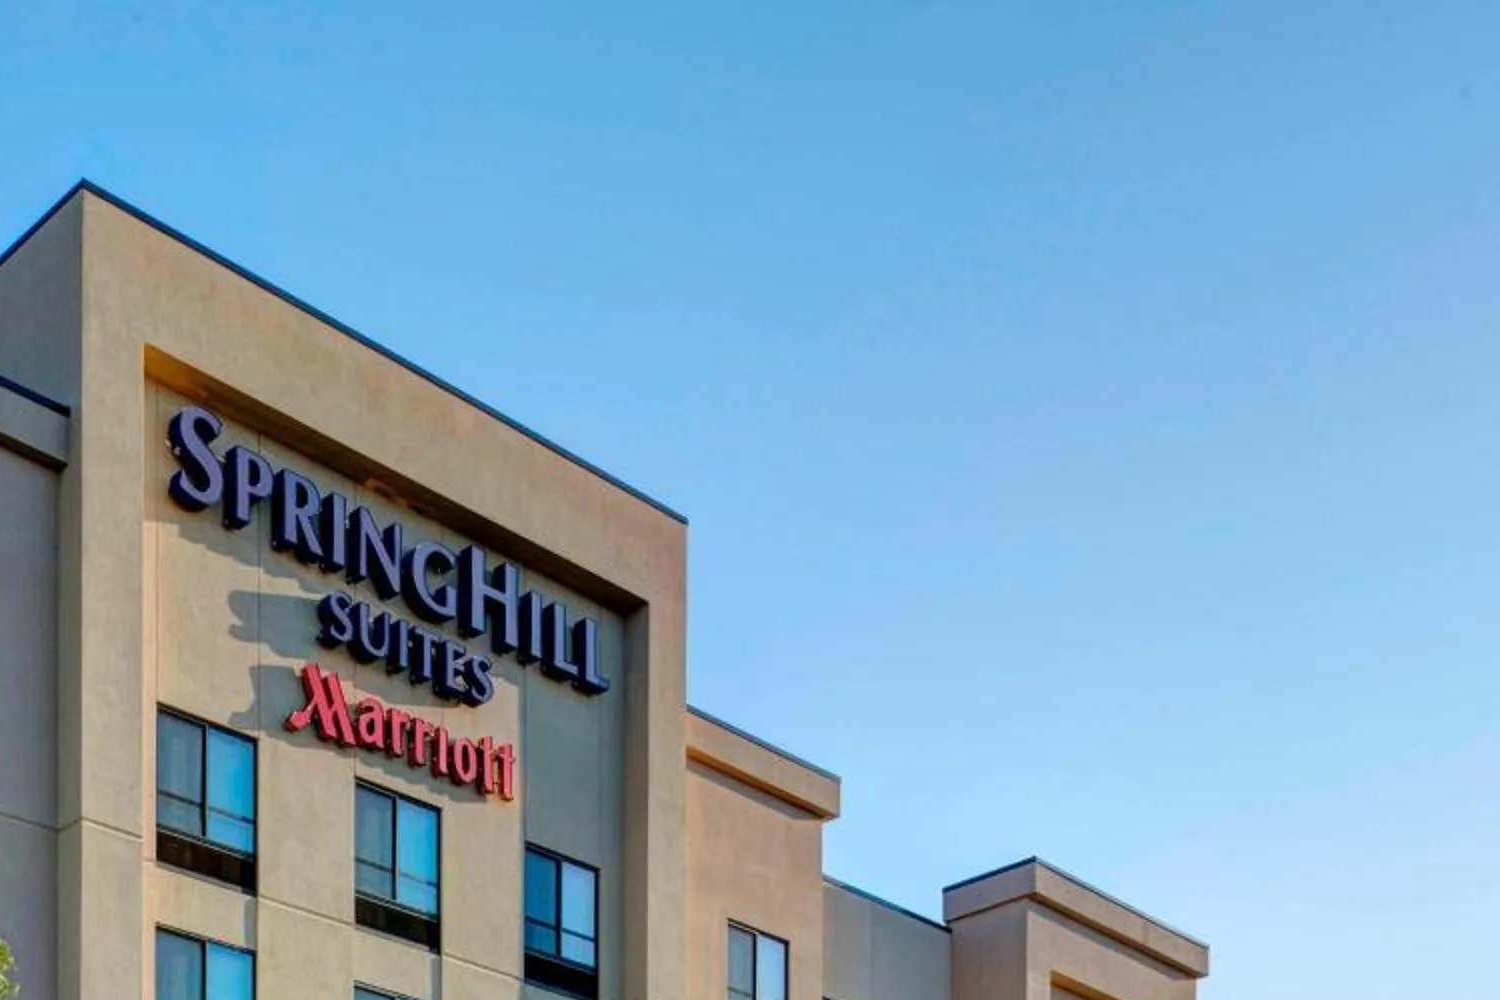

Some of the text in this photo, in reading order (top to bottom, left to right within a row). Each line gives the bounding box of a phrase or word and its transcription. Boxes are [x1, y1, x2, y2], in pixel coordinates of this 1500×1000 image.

[169, 405, 609, 694] SPRINGHILL
[316, 591, 495, 705] SUITES
[284, 662, 516, 801] Marriott
